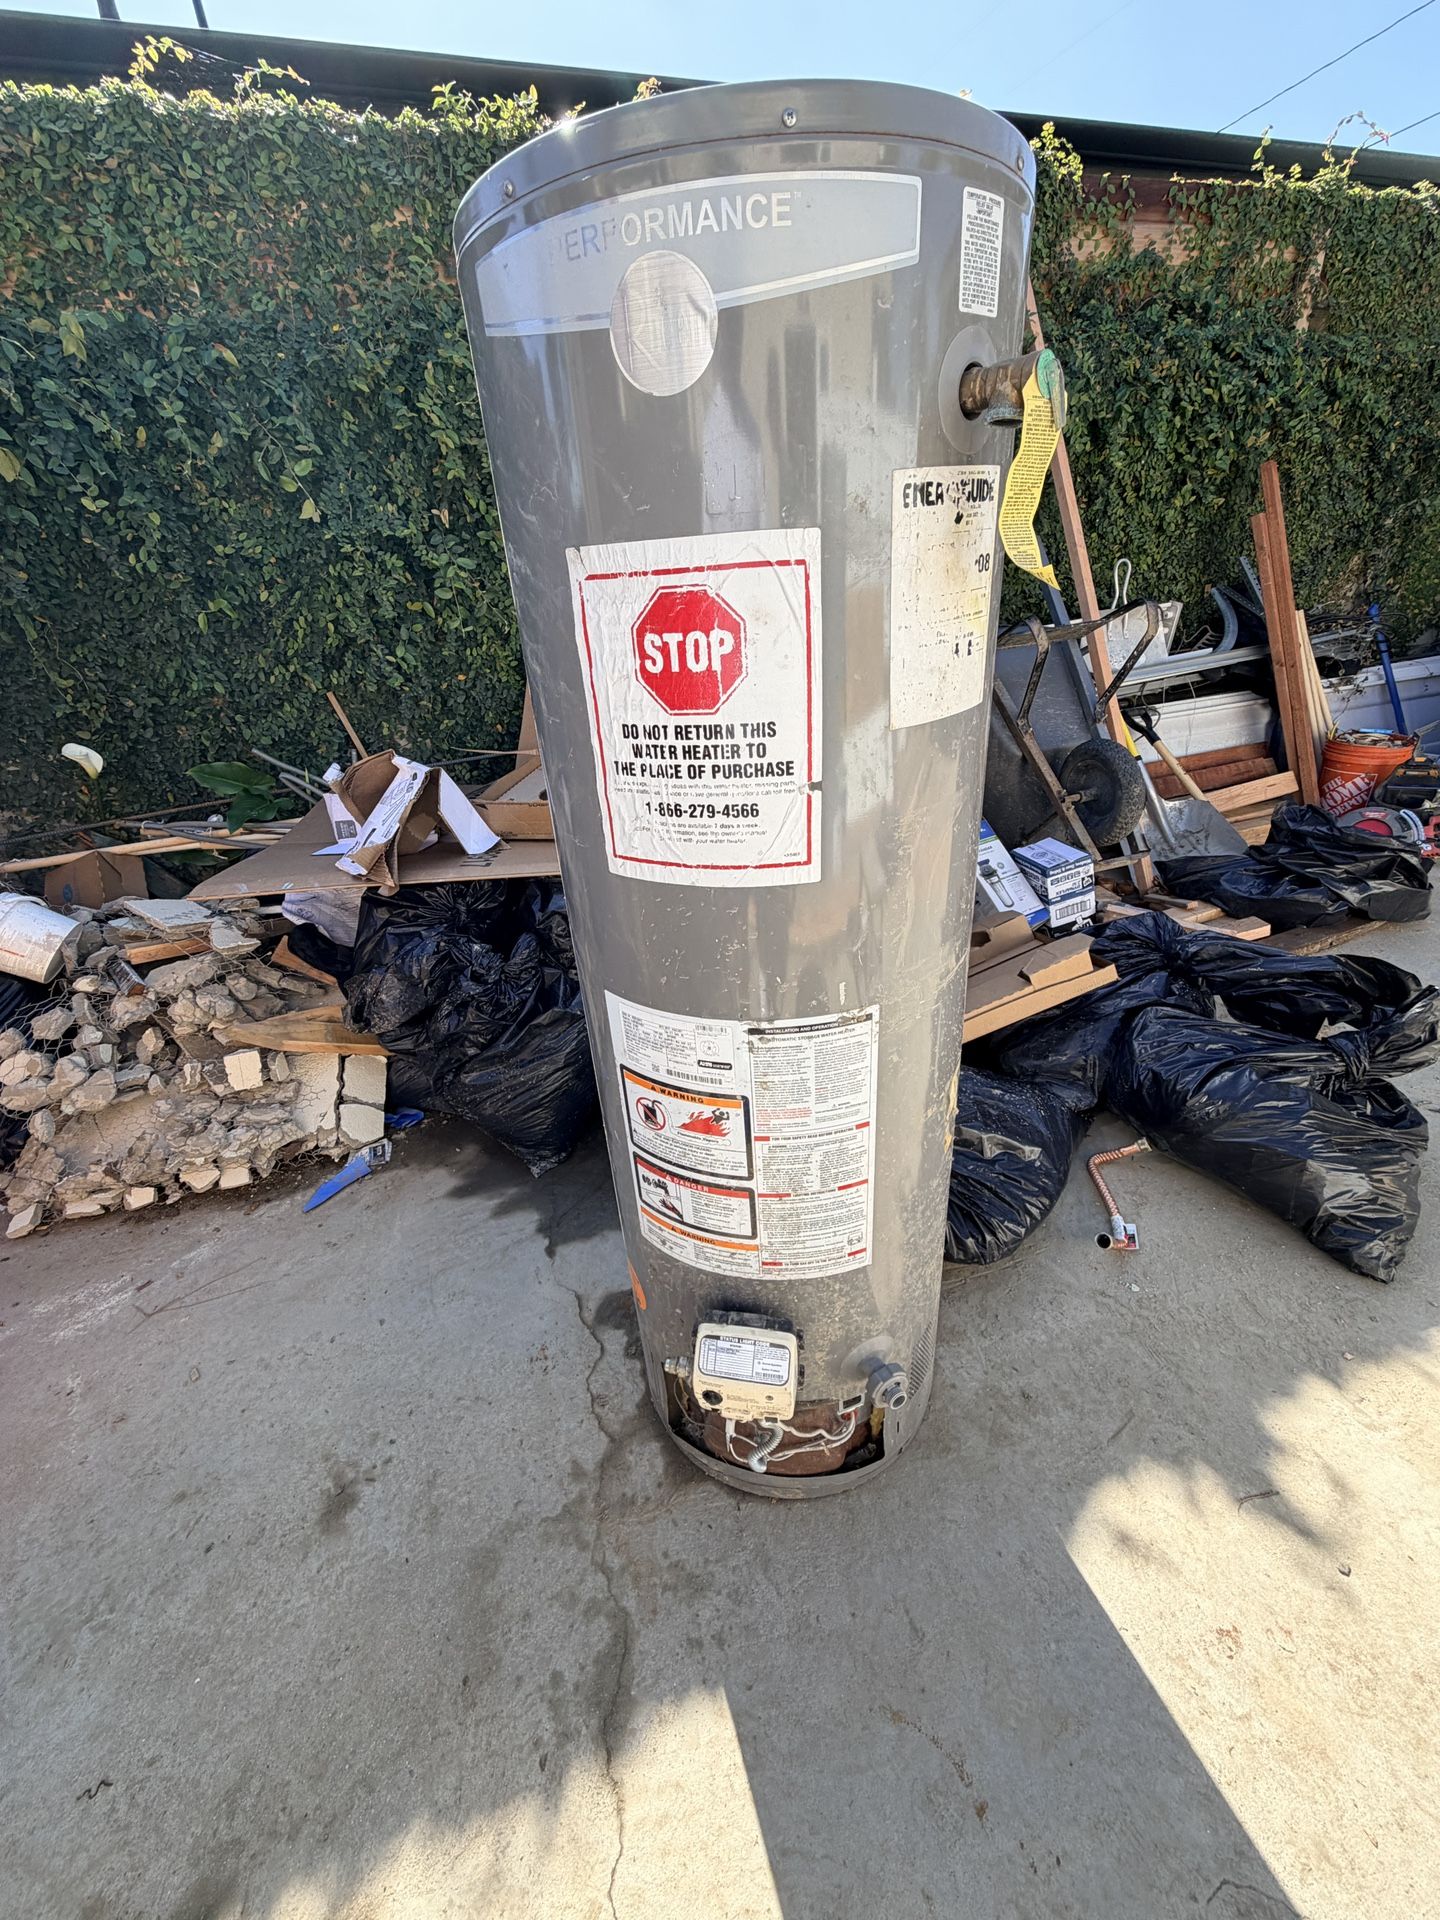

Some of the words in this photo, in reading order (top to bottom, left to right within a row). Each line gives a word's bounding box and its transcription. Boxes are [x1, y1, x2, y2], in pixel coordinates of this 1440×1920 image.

[561, 191, 793, 262] ERFORMANCE
[644, 629, 734, 674] STOP
[622, 724, 639, 740] DO
[642, 724, 668, 740] NOT
[674, 724, 735, 740] RETURN
[740, 722, 776, 738] THIS
[632, 744, 678, 760] WATER
[682, 744, 740, 760] HEATER
[746, 742, 766, 758] TO
[614, 760, 636, 777] THE
[640, 764, 682, 779] PLACE
[688, 764, 706, 779] OF
[712, 760, 794, 779] PURCHASE
[1322, 776, 1344, 793] THE
[645, 802, 760, 818] 1-866-279-4566
[659, 1088, 704, 1104] WARNING
[673, 1178, 709, 1192] DANGER
[680, 1230, 716, 1245] WARNING
